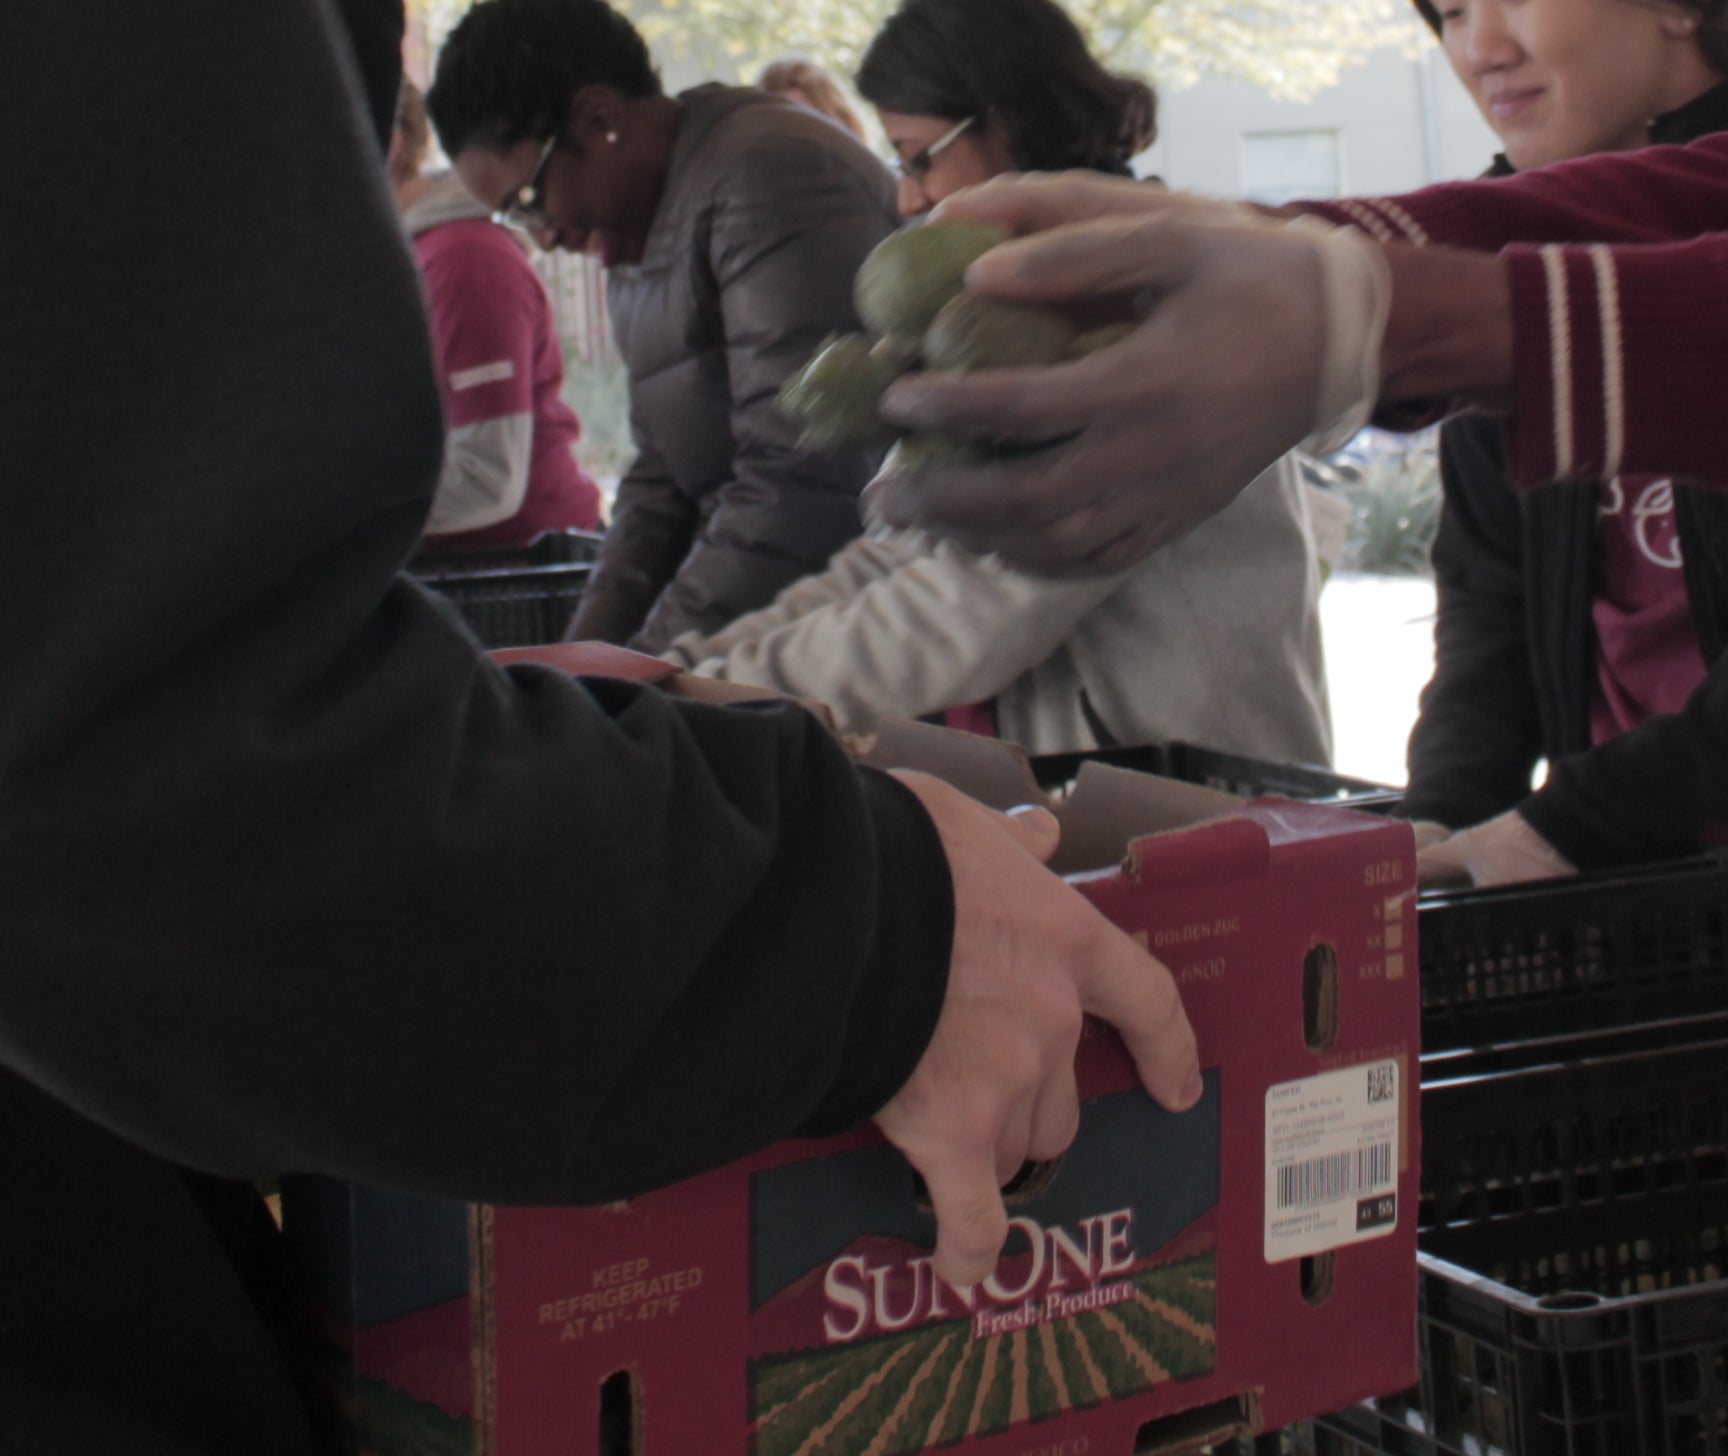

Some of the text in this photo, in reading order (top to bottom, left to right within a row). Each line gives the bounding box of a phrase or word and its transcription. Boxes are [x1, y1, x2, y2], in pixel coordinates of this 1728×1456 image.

[1365, 860, 1403, 887] SIZE
[1154, 922, 1211, 948] GOLDEN
[592, 1257, 650, 1289] KEEP
[538, 1267, 703, 1326] REFRIGERATED
[561, 1317, 587, 1343] AT
[975, 1300, 1036, 1338] Fresh
